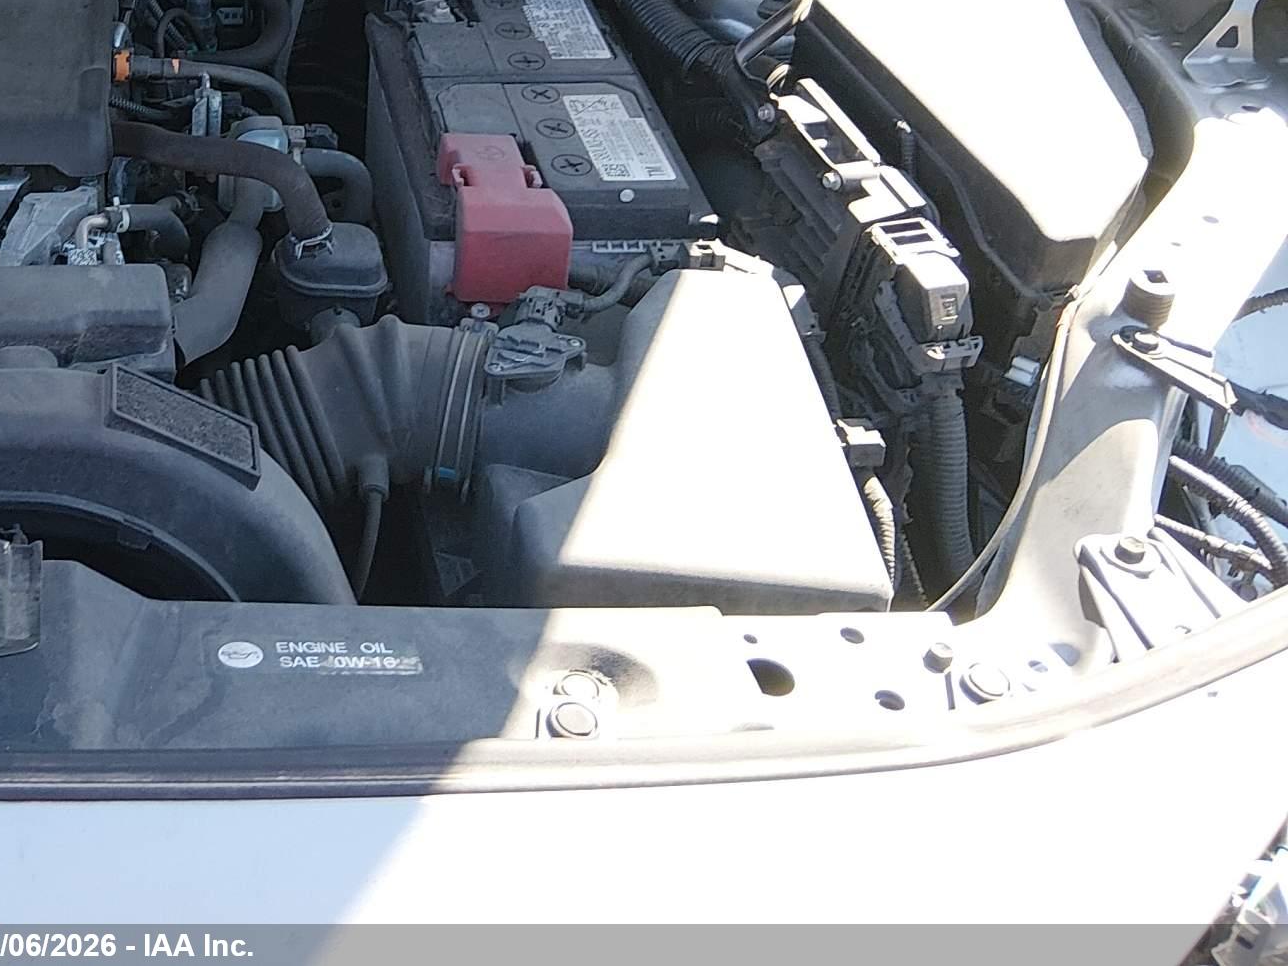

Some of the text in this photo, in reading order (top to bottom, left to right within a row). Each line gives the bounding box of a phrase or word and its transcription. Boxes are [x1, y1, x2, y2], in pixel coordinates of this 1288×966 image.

[275, 641, 394, 654] ENGINE OIL
[279, 656, 321, 668] SAE
